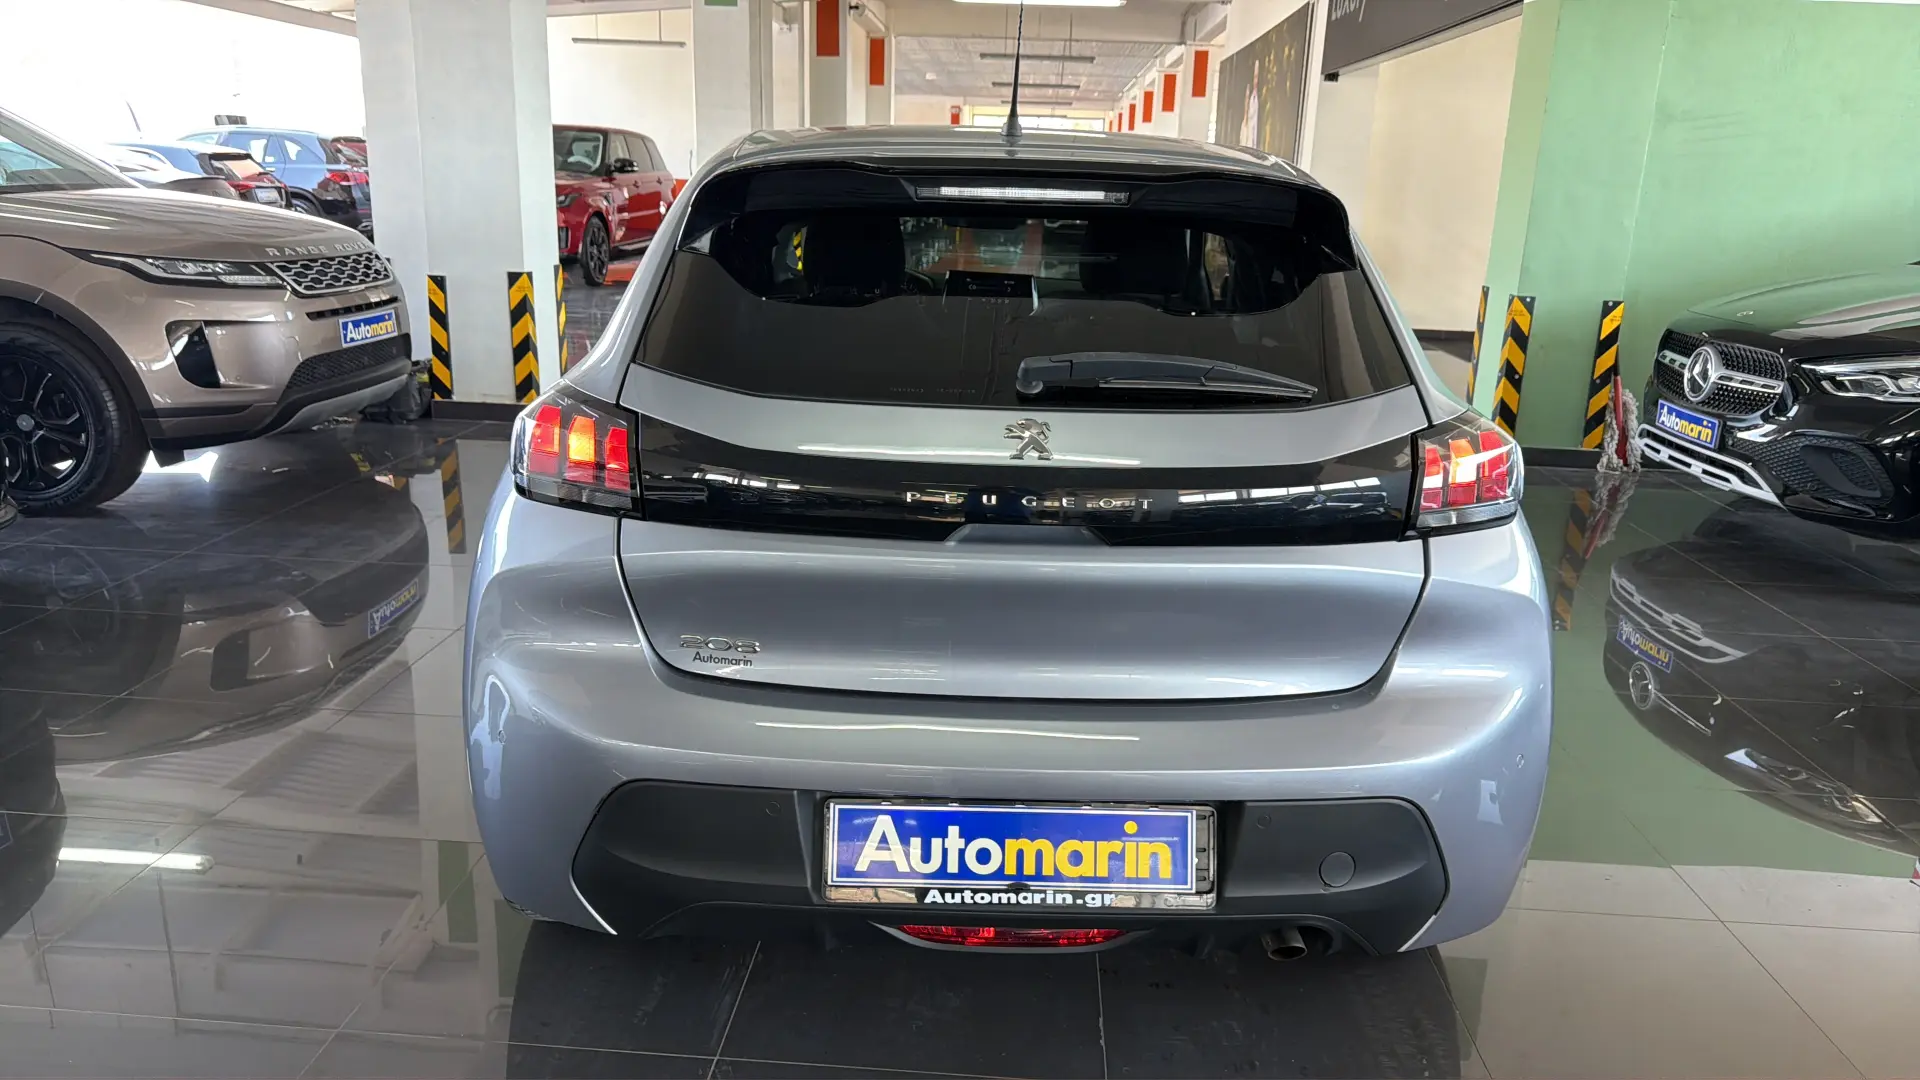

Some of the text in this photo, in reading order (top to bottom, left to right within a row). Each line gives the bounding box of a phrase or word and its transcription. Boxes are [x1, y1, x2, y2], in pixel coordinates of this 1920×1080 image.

[265, 245, 328, 257] RANGE
[346, 314, 395, 342] Automarin
[1659, 405, 1713, 443] Automarin
[906, 491, 1152, 509] PEUGEOT
[680, 634, 760, 653] 208
[692, 651, 753, 667] Automarin
[854, 814, 1172, 879] Automarin
[924, 889, 1115, 907] Automarin.gr
